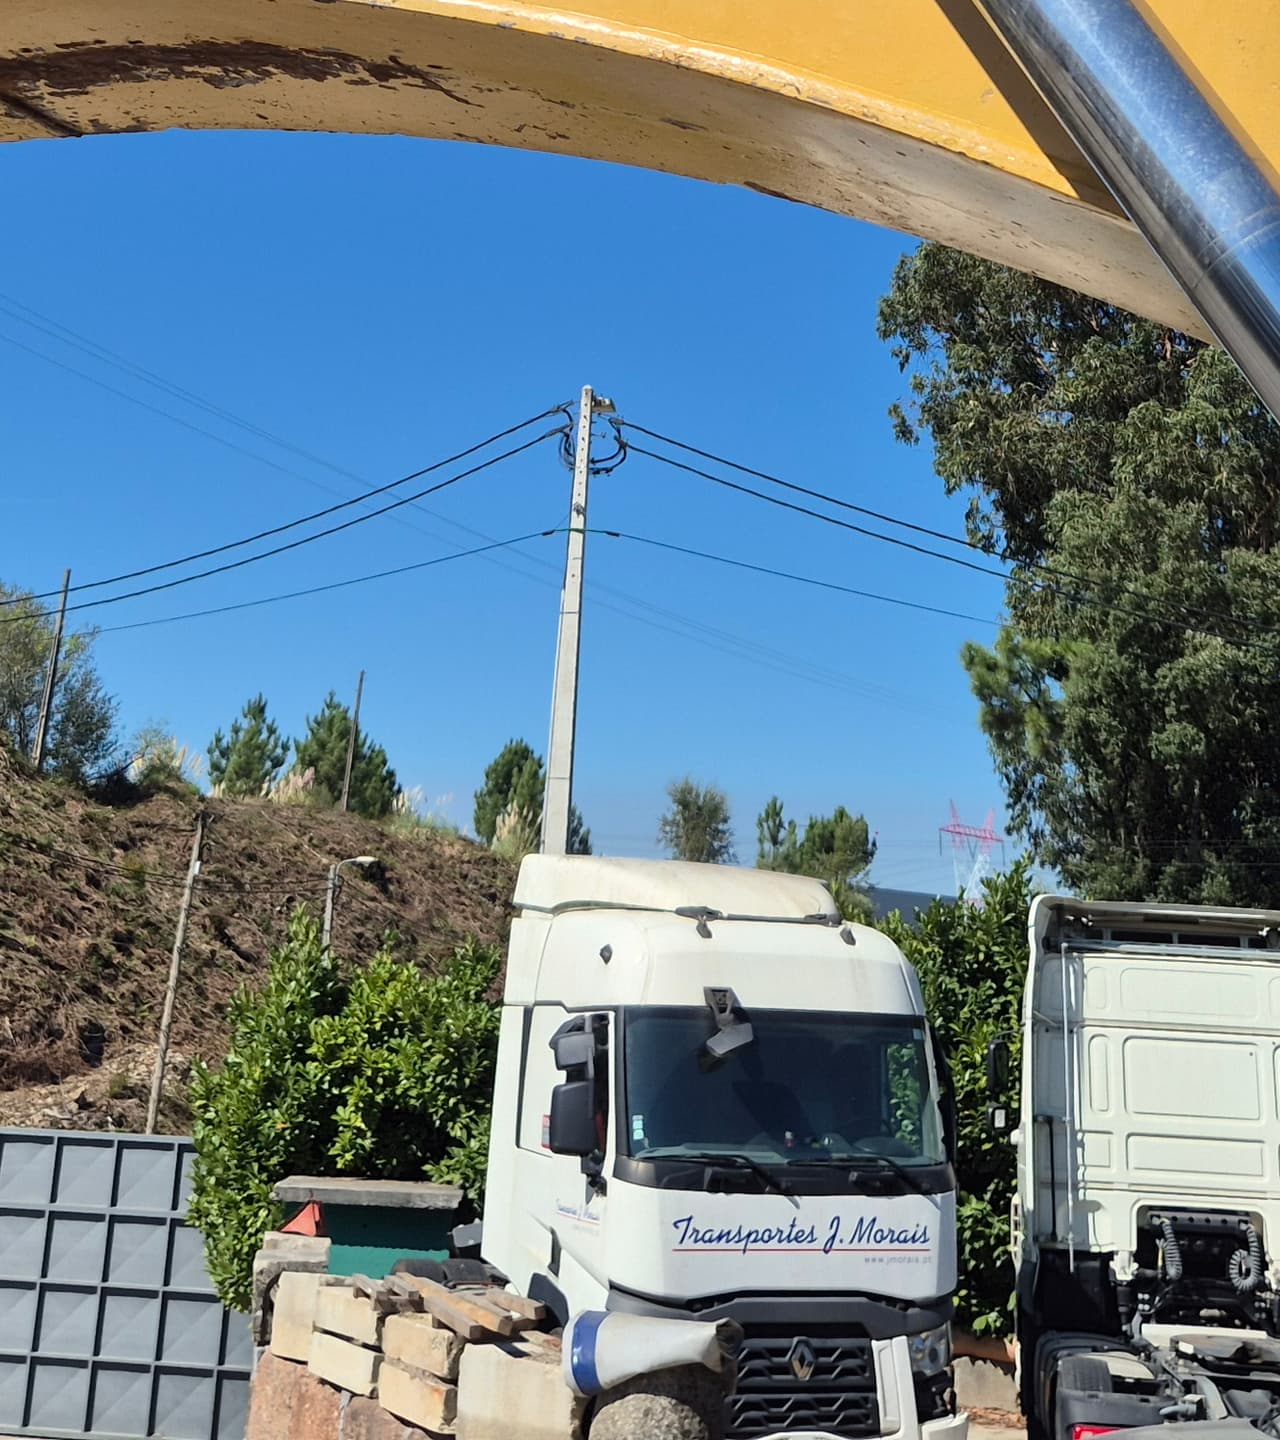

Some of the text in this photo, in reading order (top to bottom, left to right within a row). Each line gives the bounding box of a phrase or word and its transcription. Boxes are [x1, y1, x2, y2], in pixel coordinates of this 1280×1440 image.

[673, 1215, 930, 1254] Transportes J. Morais
